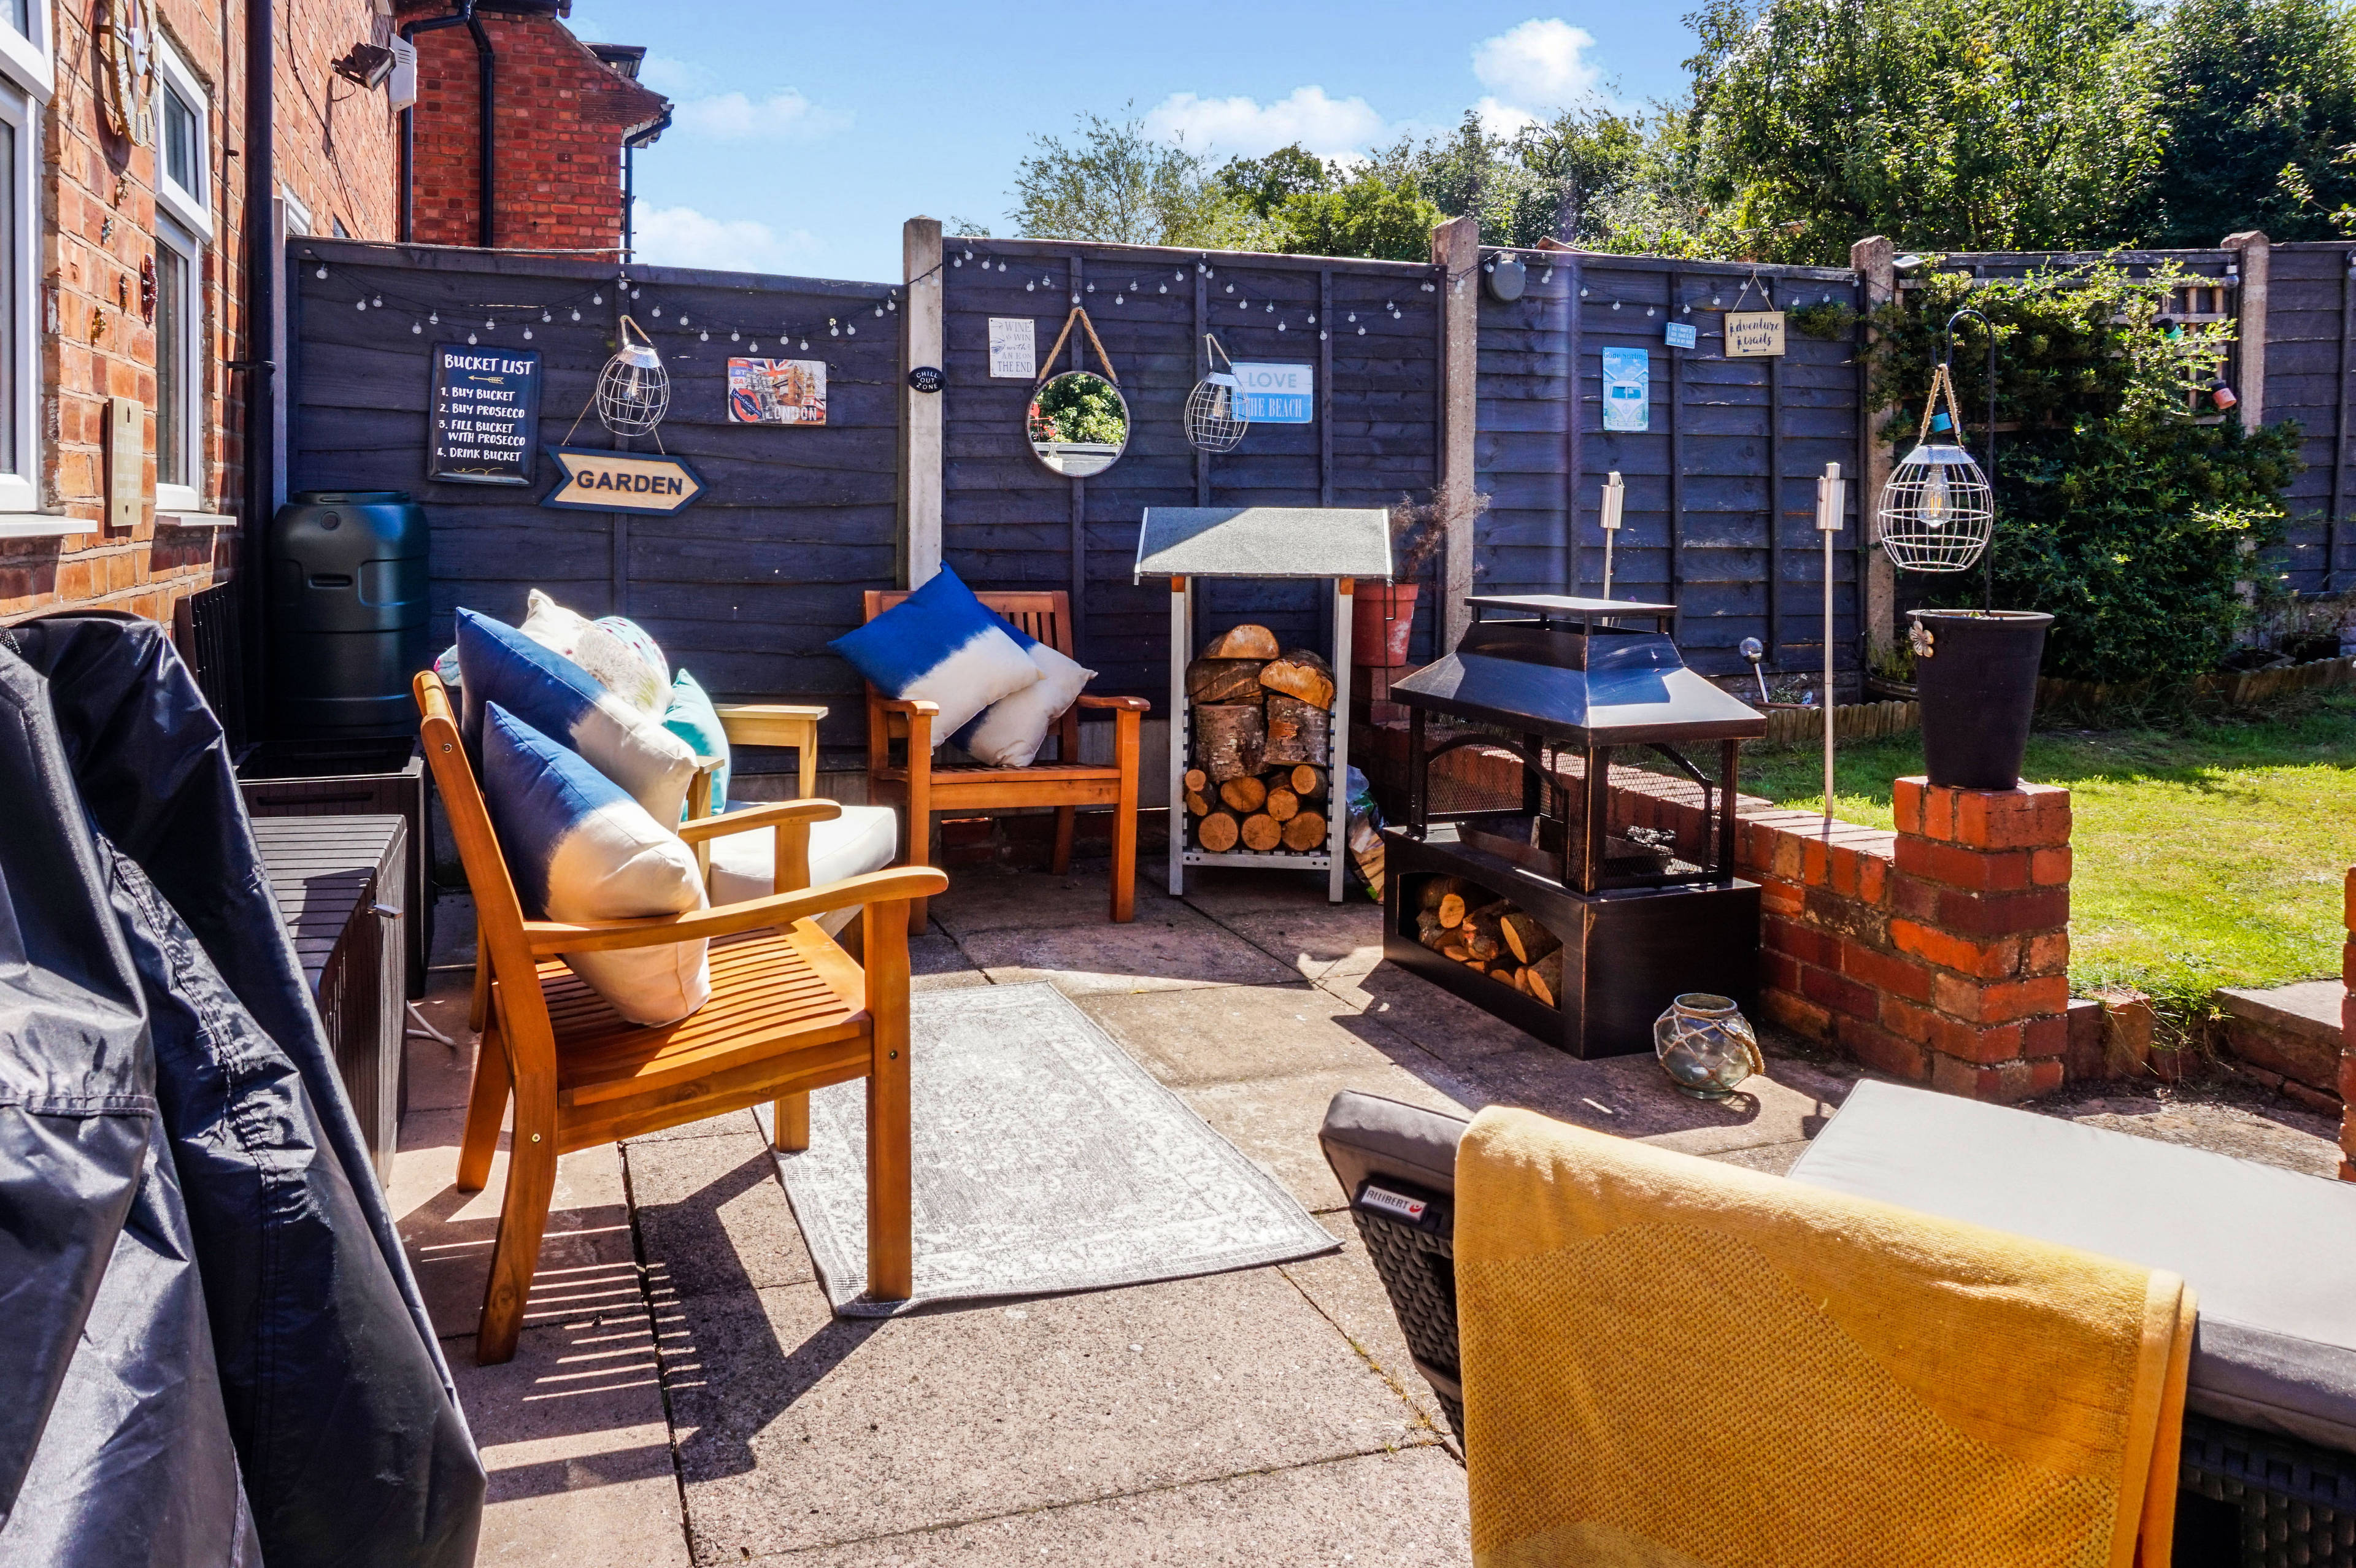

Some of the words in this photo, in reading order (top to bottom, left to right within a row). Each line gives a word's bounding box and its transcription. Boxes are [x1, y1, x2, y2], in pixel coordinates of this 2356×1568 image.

[1005, 321, 1031, 332] WINE
[1730, 317, 1780, 337] Adventure
[444, 354, 499, 372] BUCKET
[502, 359, 534, 375] LIST
[998, 361, 1014, 372] THE
[1016, 361, 1032, 372] END
[1248, 372, 1297, 388] LOVE
[441, 387, 448, 396] 1.
[452, 386, 474, 398] BUY
[476, 389, 515, 402] BUCKET
[439, 403, 448, 413] 2.
[452, 403, 474, 415] BUY
[476, 405, 525, 418] PROSECCO
[733, 390, 761, 417] UNDERGROUND
[1269, 398, 1302, 418] BEACH
[765, 405, 817, 421] LONDON
[438, 420, 448, 429] 3.
[451, 420, 473, 431] FILL
[475, 421, 515, 434] BUCKET
[448, 432, 474, 443] WITH
[477, 433, 526, 447] PROSECCO
[437, 447, 447, 457] 4.
[450, 447, 481, 459] DRINK
[483, 450, 522, 462] BUCKET
[576, 470, 683, 496] GARDEN
